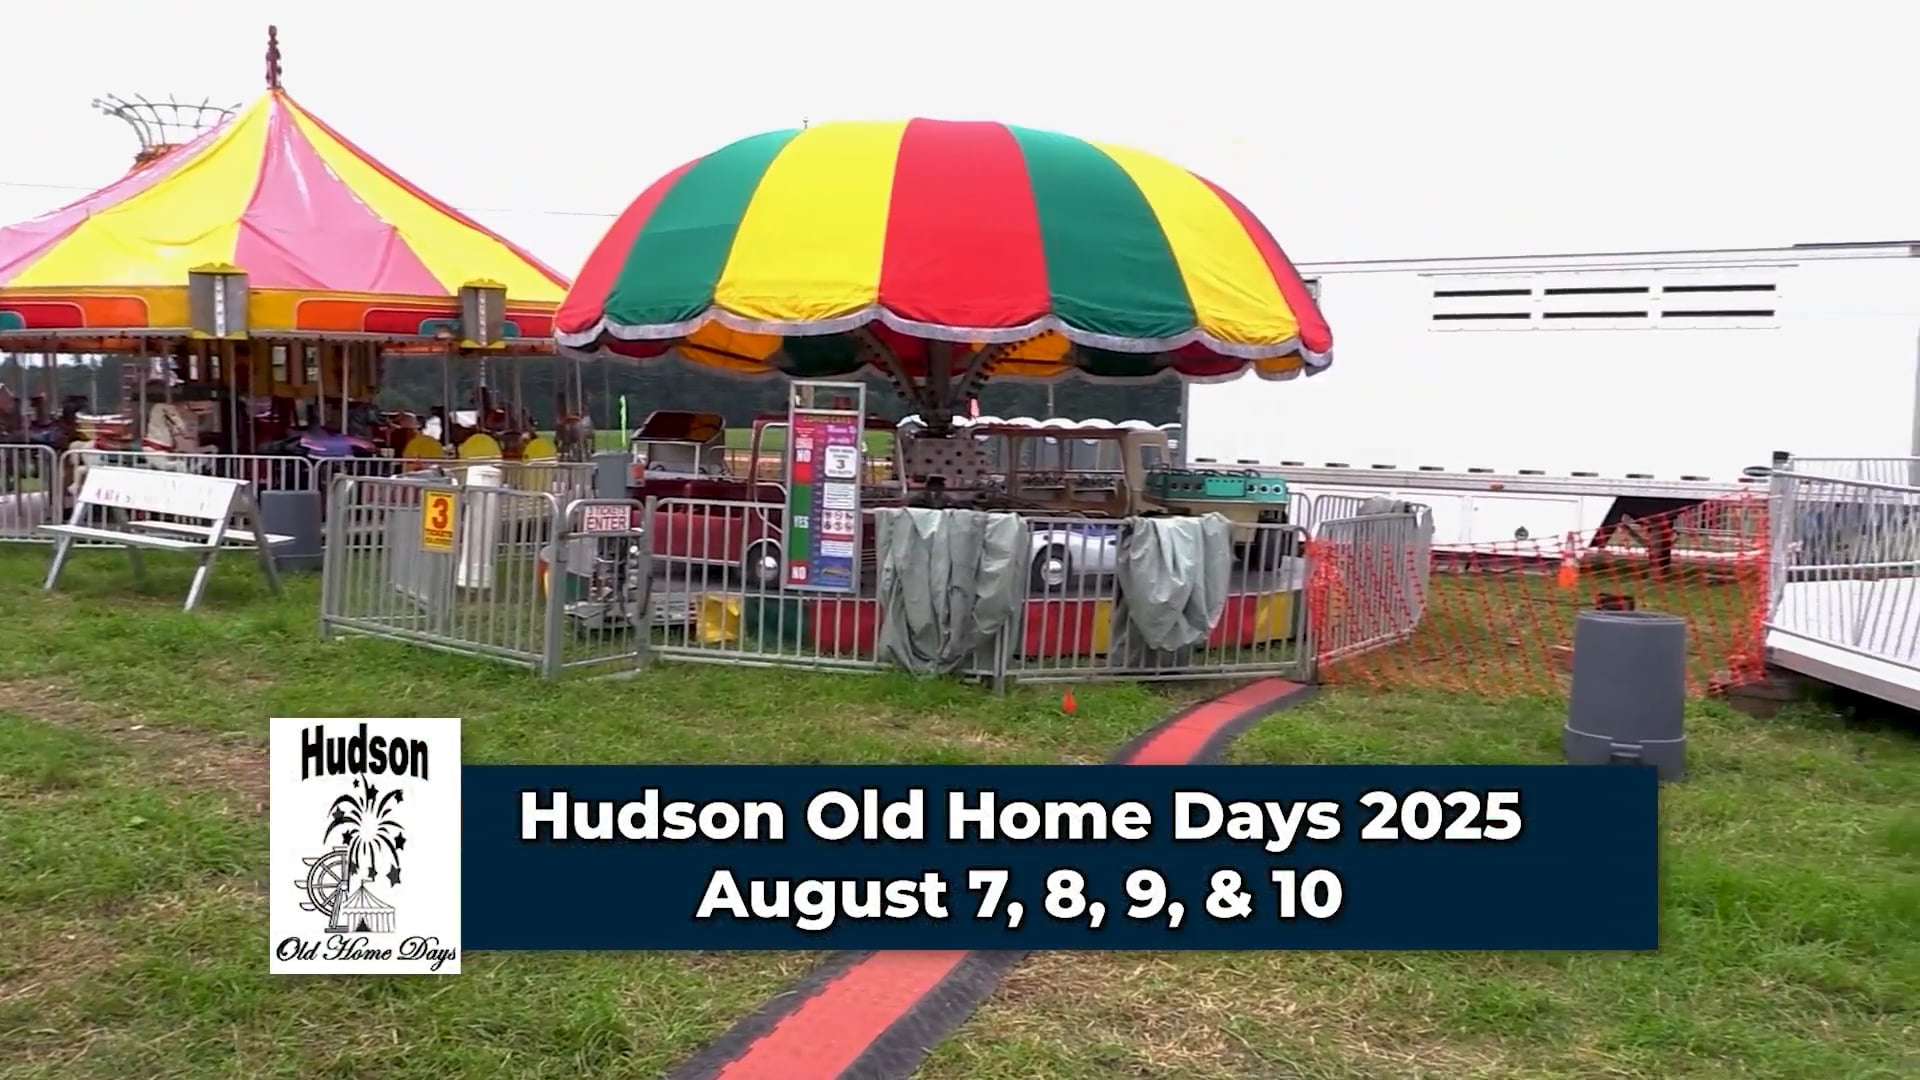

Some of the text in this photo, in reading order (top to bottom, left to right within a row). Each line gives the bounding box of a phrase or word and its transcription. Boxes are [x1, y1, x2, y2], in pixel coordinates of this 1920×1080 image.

[836, 460, 845, 469] 3
[432, 498, 448, 529] 3
[587, 516, 626, 530] ENTER
[794, 515, 809, 528] YES
[791, 566, 807, 580] NO
